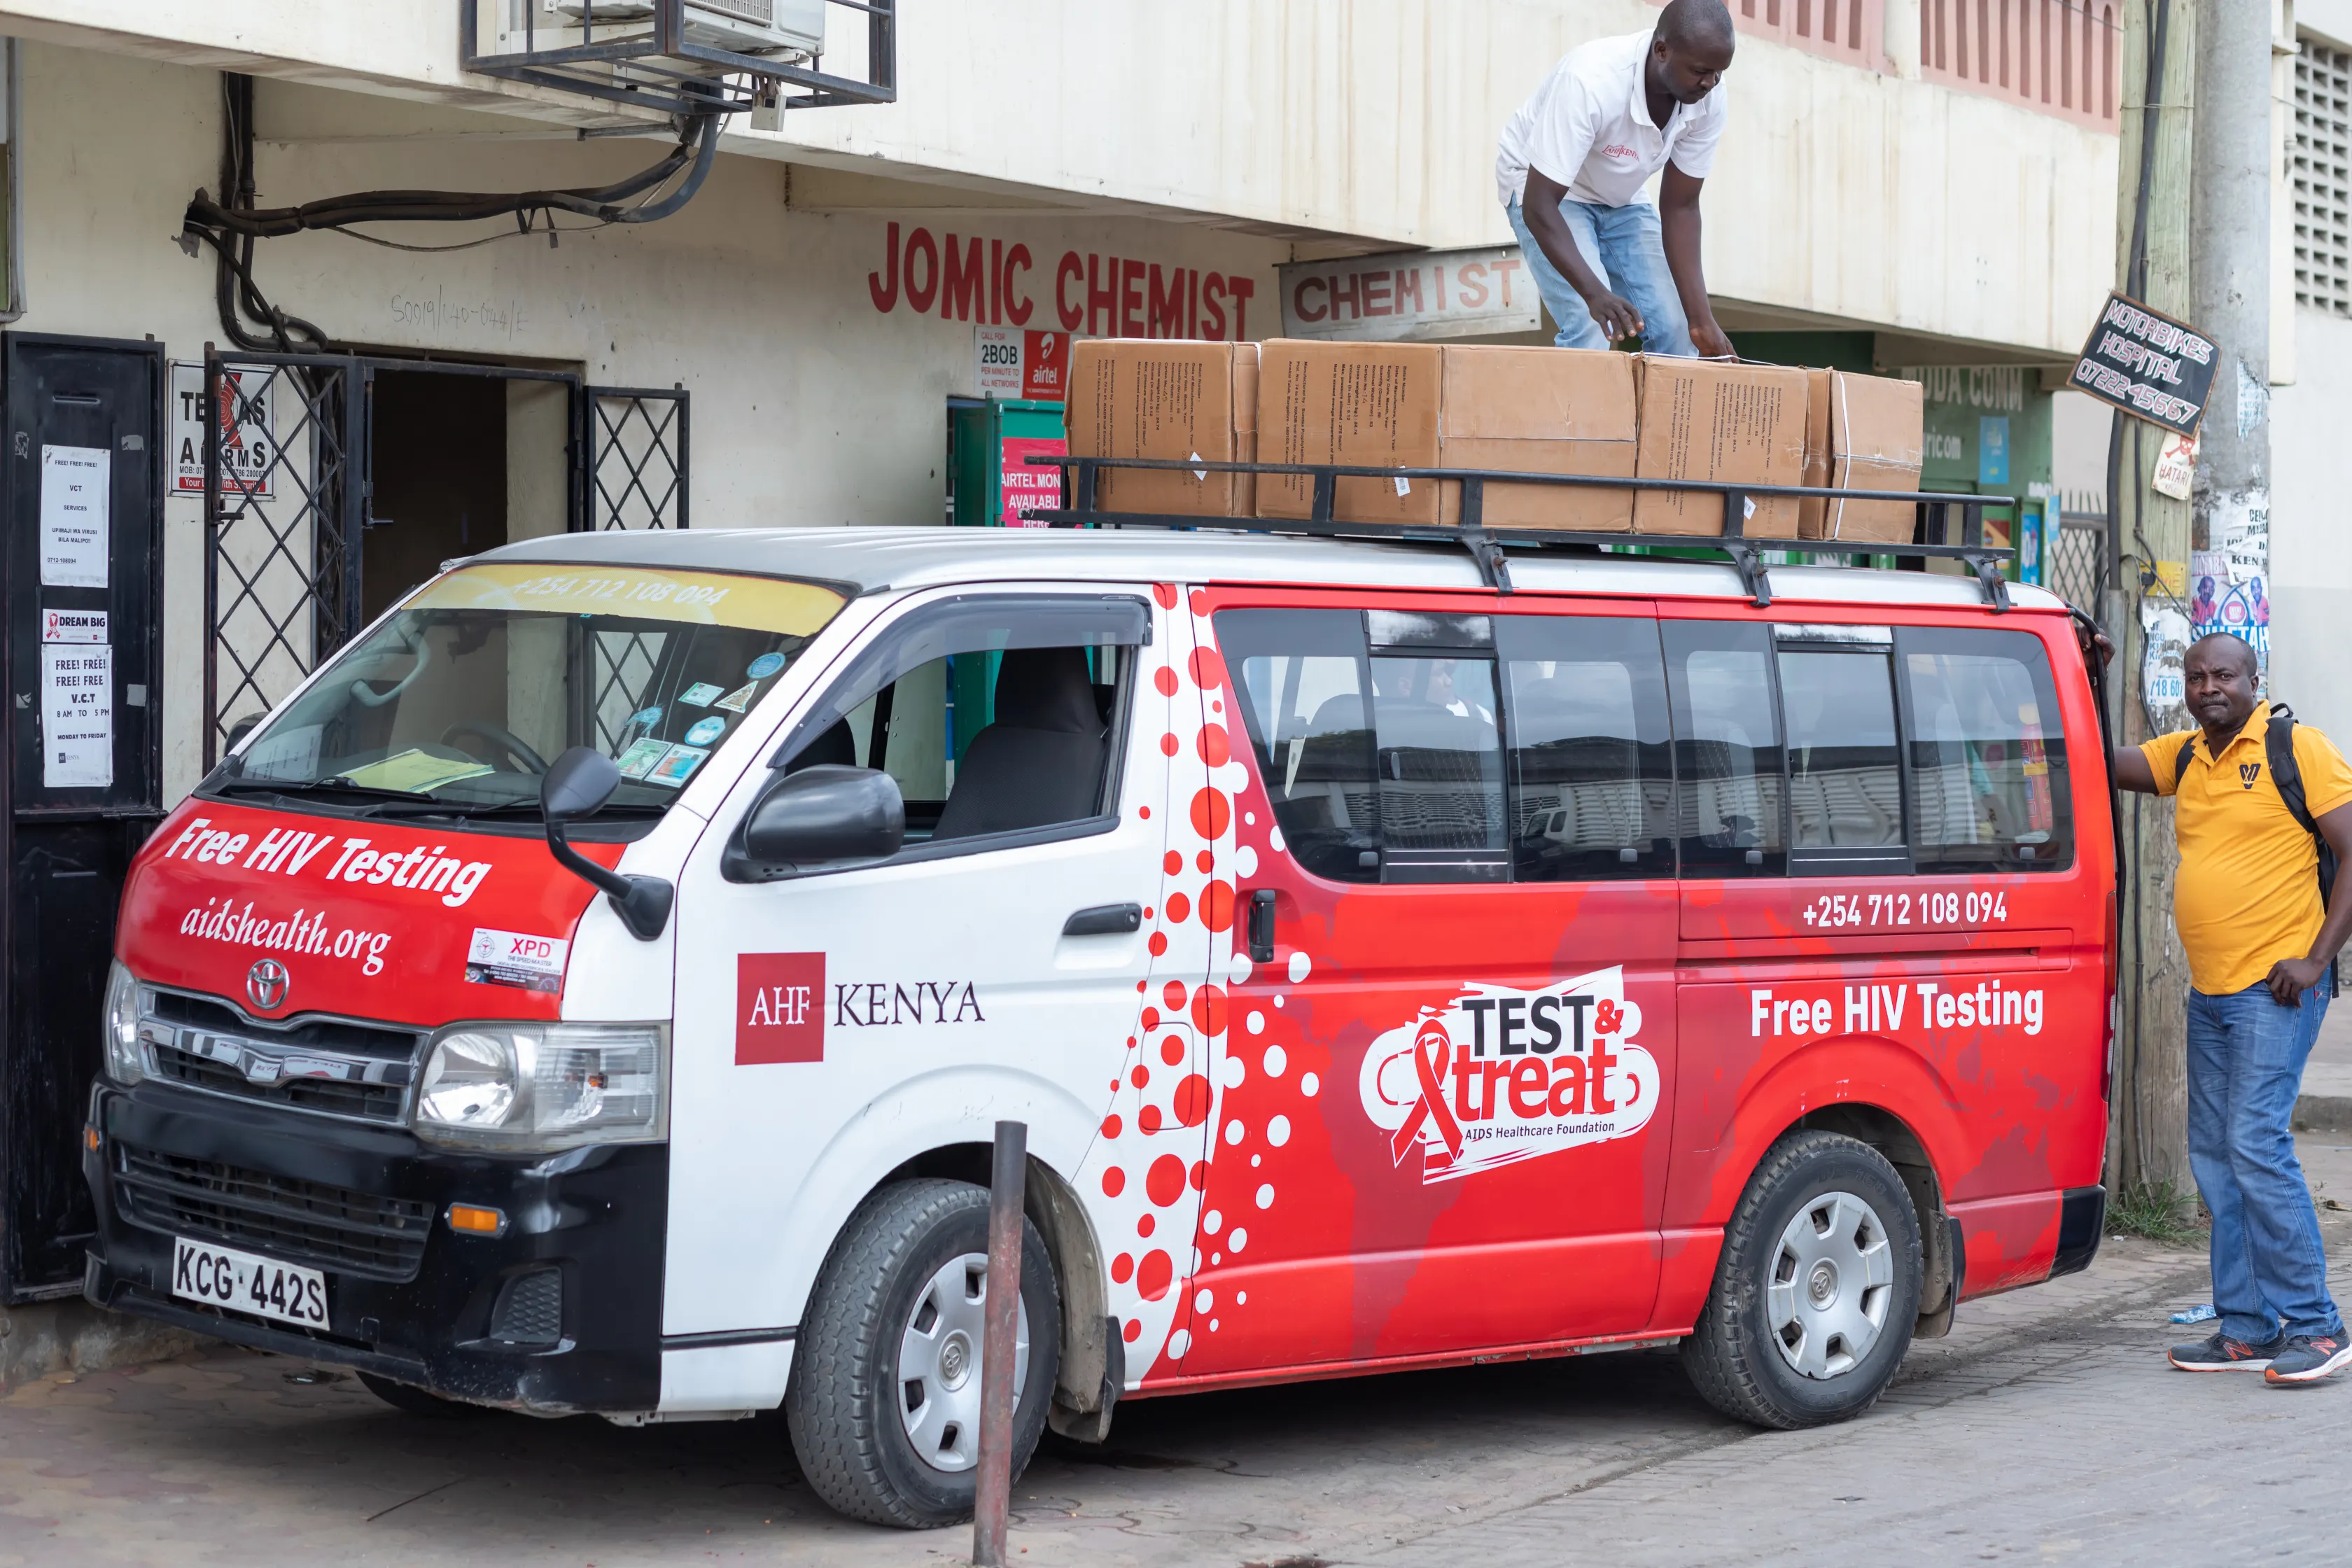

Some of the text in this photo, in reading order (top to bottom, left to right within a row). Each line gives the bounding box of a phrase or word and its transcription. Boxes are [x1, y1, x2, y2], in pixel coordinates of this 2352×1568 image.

[868, 221, 1254, 342] JOMIC CHEMIST
[1294, 259, 1520, 323] CHEMIST
[2102, 299, 2213, 365] MOTORBIKES
[982, 344, 1018, 364] 2BOB
[2097, 330, 2182, 385] HOSPITAL
[992, 367, 1011, 376] MINUTE
[1033, 365, 1057, 384] airtel
[991, 379, 1018, 388] NETWORKS
[185, 478, 200, 486] Your
[1002, 473, 1060, 488] AIRTEL MON
[2159, 463, 2190, 486] HATARI
[513, 577, 731, 606] +254 712 108 094
[59, 617, 106, 627] DREAM BIG
[56, 659, 106, 670] FREE! FREE!
[56, 676, 104, 686] FREE! FREE
[71, 694, 95, 703] V.C.T
[165, 818, 493, 908] Free HIV Testing
[1803, 891, 2007, 927] +254 712 108 094
[180, 897, 391, 976] aidshealth.org
[510, 938, 551, 958] XPD
[748, 981, 986, 1026] AHF KENYA
[1751, 979, 2043, 1037] Free HIV Testing
[1451, 1038, 1617, 1121] treat
[1465, 1121, 1615, 1140] AIDS Healthcare Foundation
[177, 1245, 325, 1324] KCG 442S
